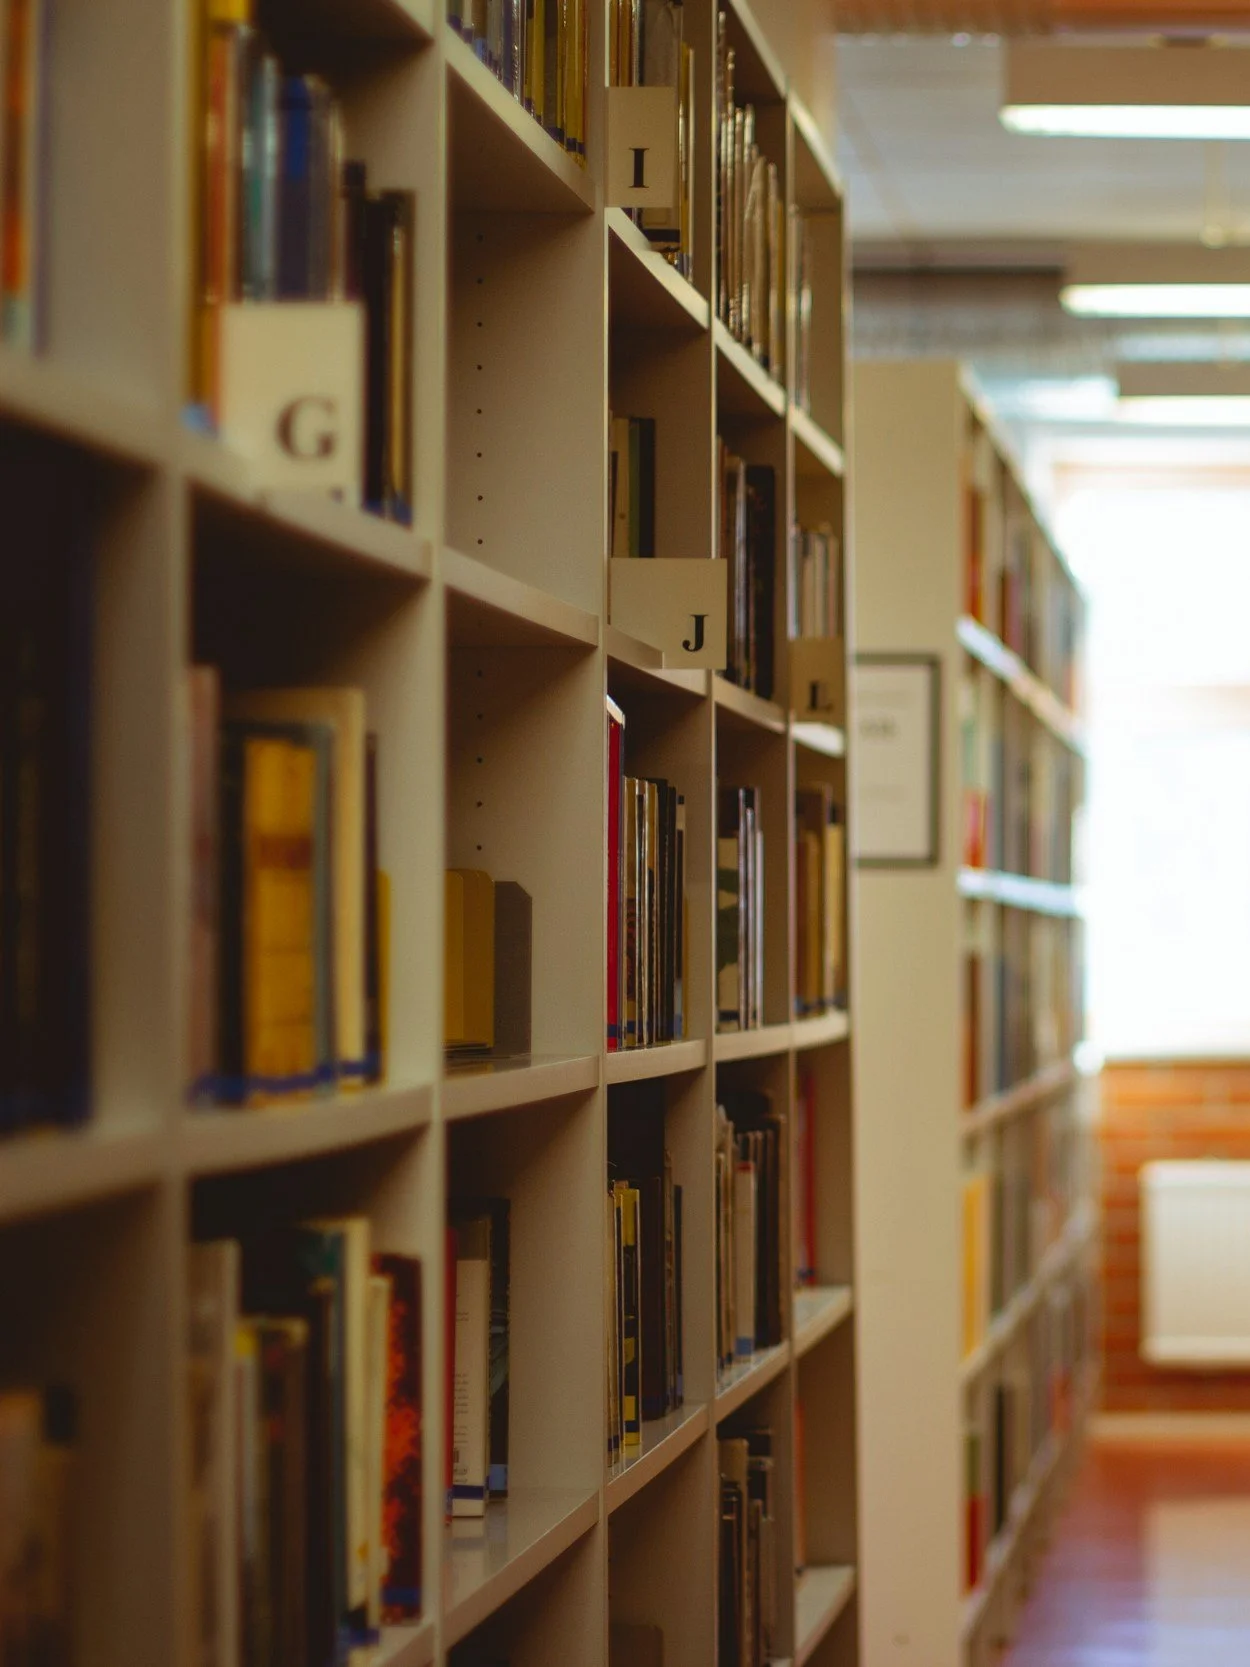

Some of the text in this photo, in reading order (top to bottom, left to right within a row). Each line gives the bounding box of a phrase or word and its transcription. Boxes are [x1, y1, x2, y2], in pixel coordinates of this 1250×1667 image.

[628, 147, 650, 188] I
[274, 395, 338, 463] G
[682, 614, 709, 652] J
[807, 680, 834, 713] L
